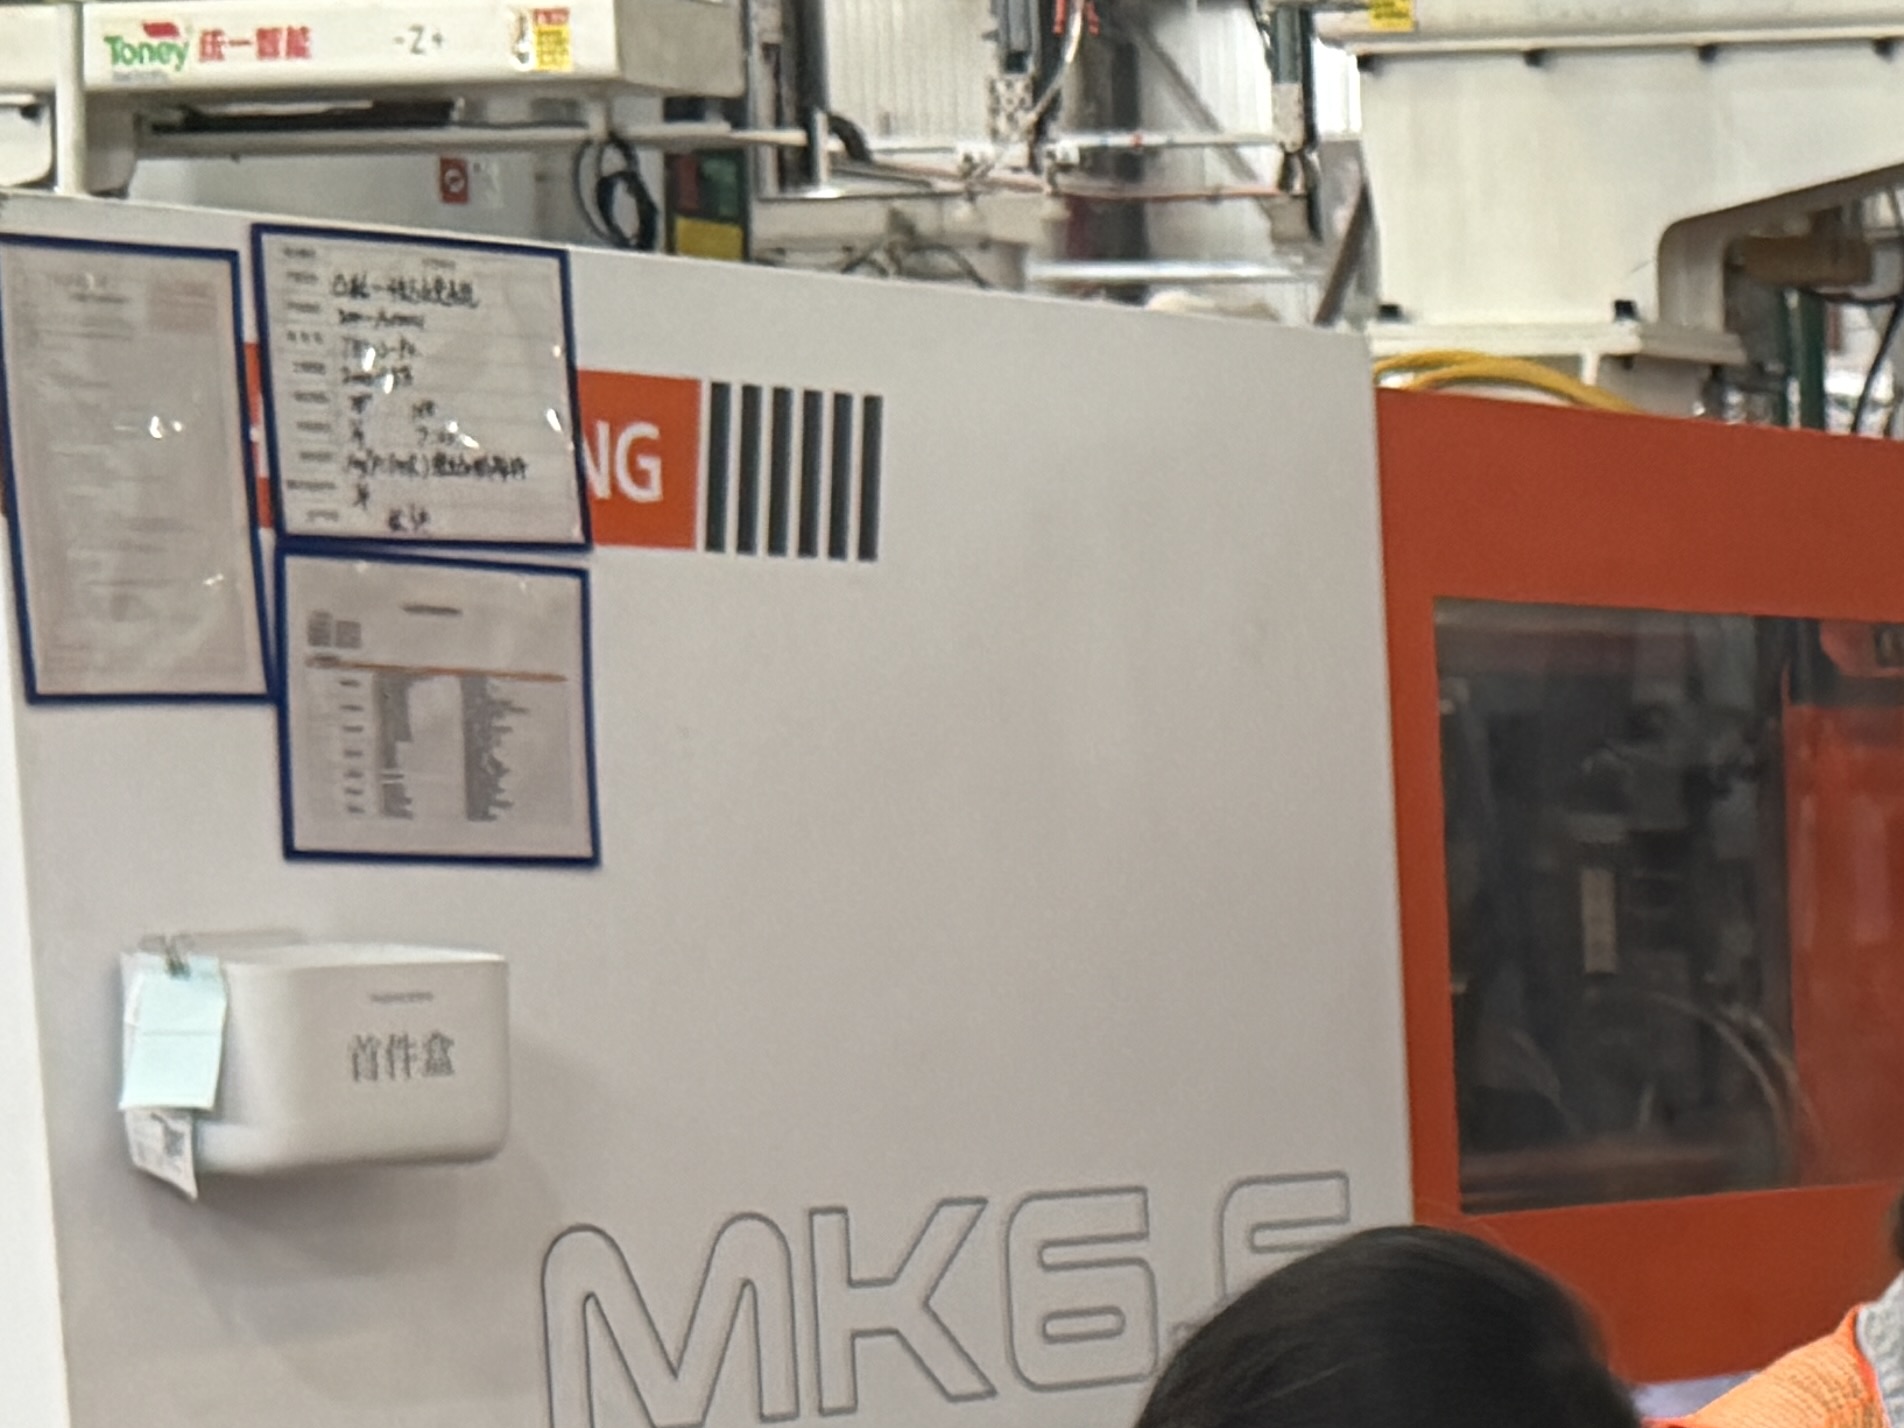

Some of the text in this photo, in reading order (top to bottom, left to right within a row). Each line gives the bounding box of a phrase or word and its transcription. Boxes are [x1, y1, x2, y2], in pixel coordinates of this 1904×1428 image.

[103, 35, 189, 71] Toney
[346, 1031, 456, 1081] 首件盒
